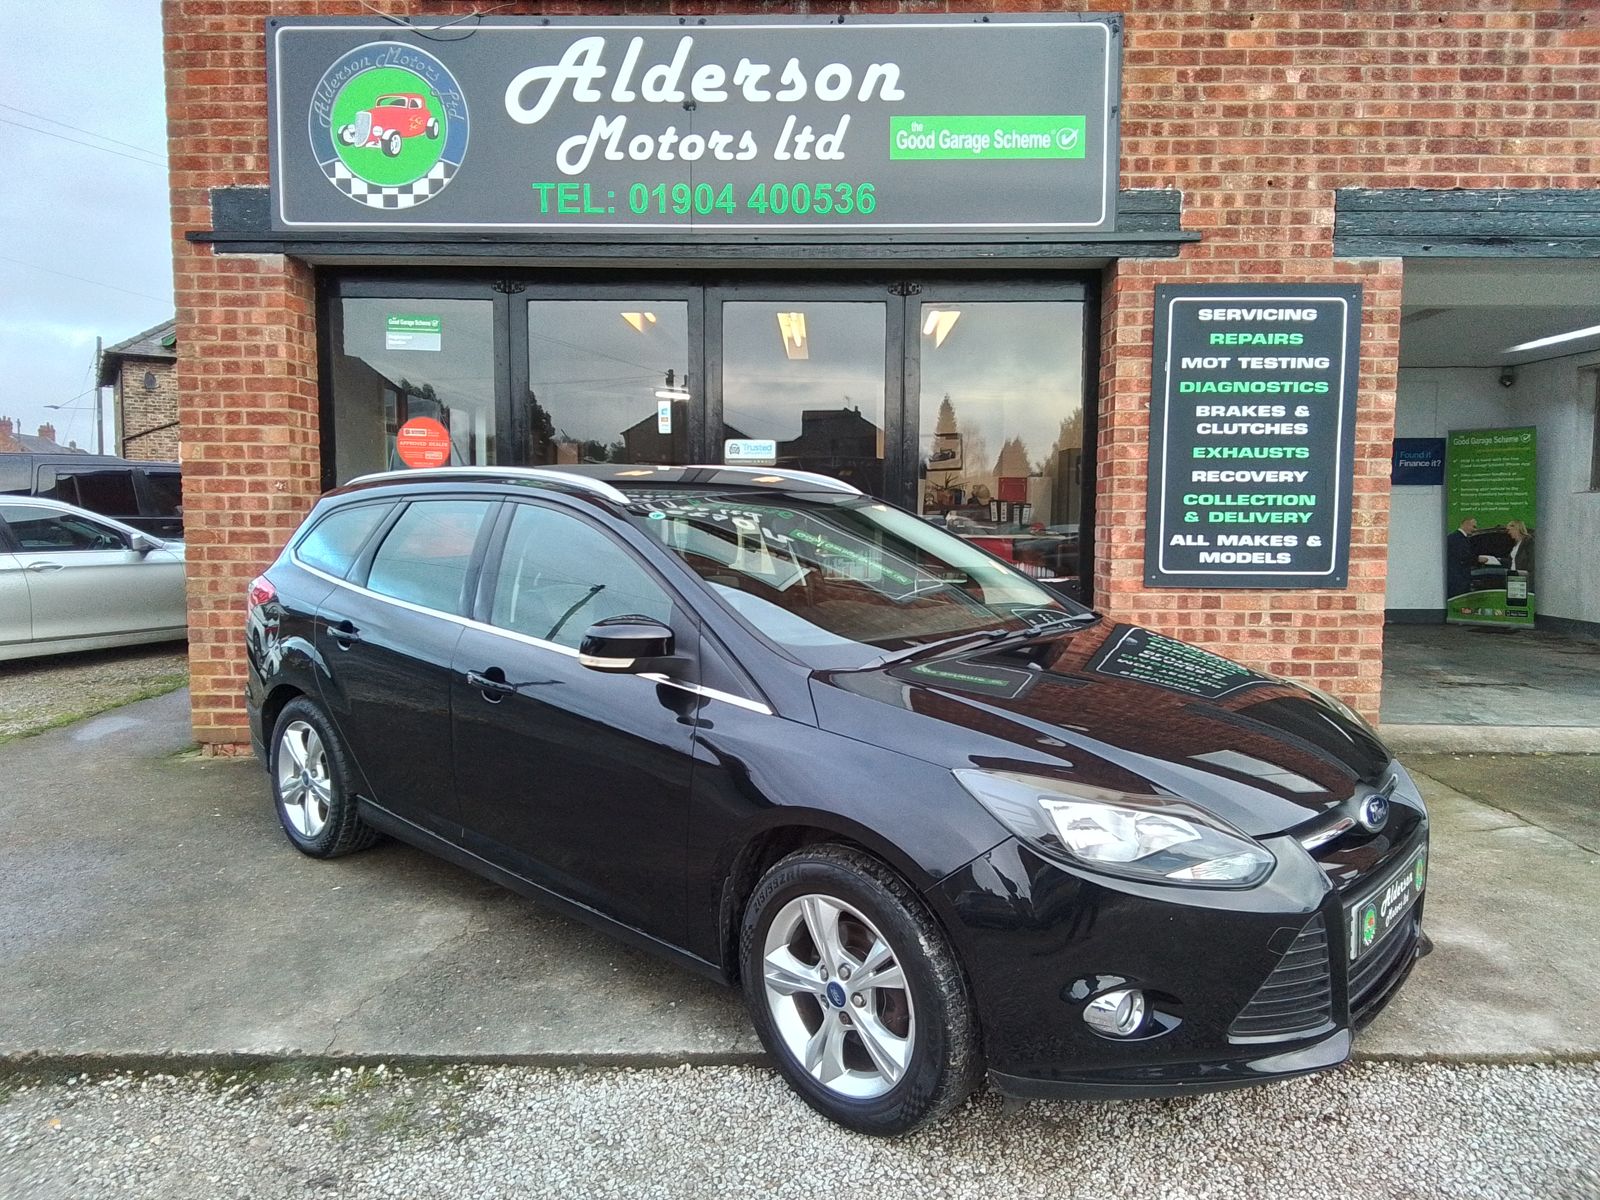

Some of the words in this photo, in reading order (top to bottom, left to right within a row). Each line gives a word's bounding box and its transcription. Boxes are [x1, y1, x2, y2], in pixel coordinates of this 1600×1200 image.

[505, 35, 906, 124] Alderson
[314, 56, 372, 128] Alderson
[376, 46, 441, 82] Motors
[911, 121, 924, 132] the
[556, 114, 758, 175] Motors
[773, 113, 851, 161] ltd
[896, 130, 935, 150] Good
[939, 131, 990, 153] Garage
[993, 129, 1051, 149] Scheme
[532, 182, 616, 214] TEL:
[629, 183, 737, 216] 01904
[747, 182, 877, 214] 400536
[1198, 308, 1318, 321] SERVICING
[1209, 333, 1304, 345] REPAIRS
[1181, 357, 1231, 369] MOT
[1238, 357, 1330, 369] TESTING
[1179, 381, 1329, 393] DIAGNOSTICS
[1195, 405, 1286, 417] BRAKES
[1294, 405, 1310, 417] &
[1196, 422, 1308, 435] CLUTCHES
[1453, 437, 1470, 446] Good
[1470, 437, 1493, 446] Garage
[1493, 435, 1519, 444] Scheme
[743, 443, 773, 452] Trusted
[1192, 447, 1310, 459] EXHAUSTS
[1399, 459, 1430, 467] Finance
[1431, 459, 1441, 467] it?
[1191, 470, 1309, 483] RECOVERY
[1183, 494, 1316, 506] COLLECTION
[1184, 511, 1199, 523] &
[1208, 511, 1313, 523] DELIVERY
[1169, 534, 1210, 546] ALL
[1217, 535, 1298, 547] MAKES
[1306, 535, 1322, 547] &
[1199, 552, 1291, 564] MODELS
[1380, 872, 1413, 918] Alderson
